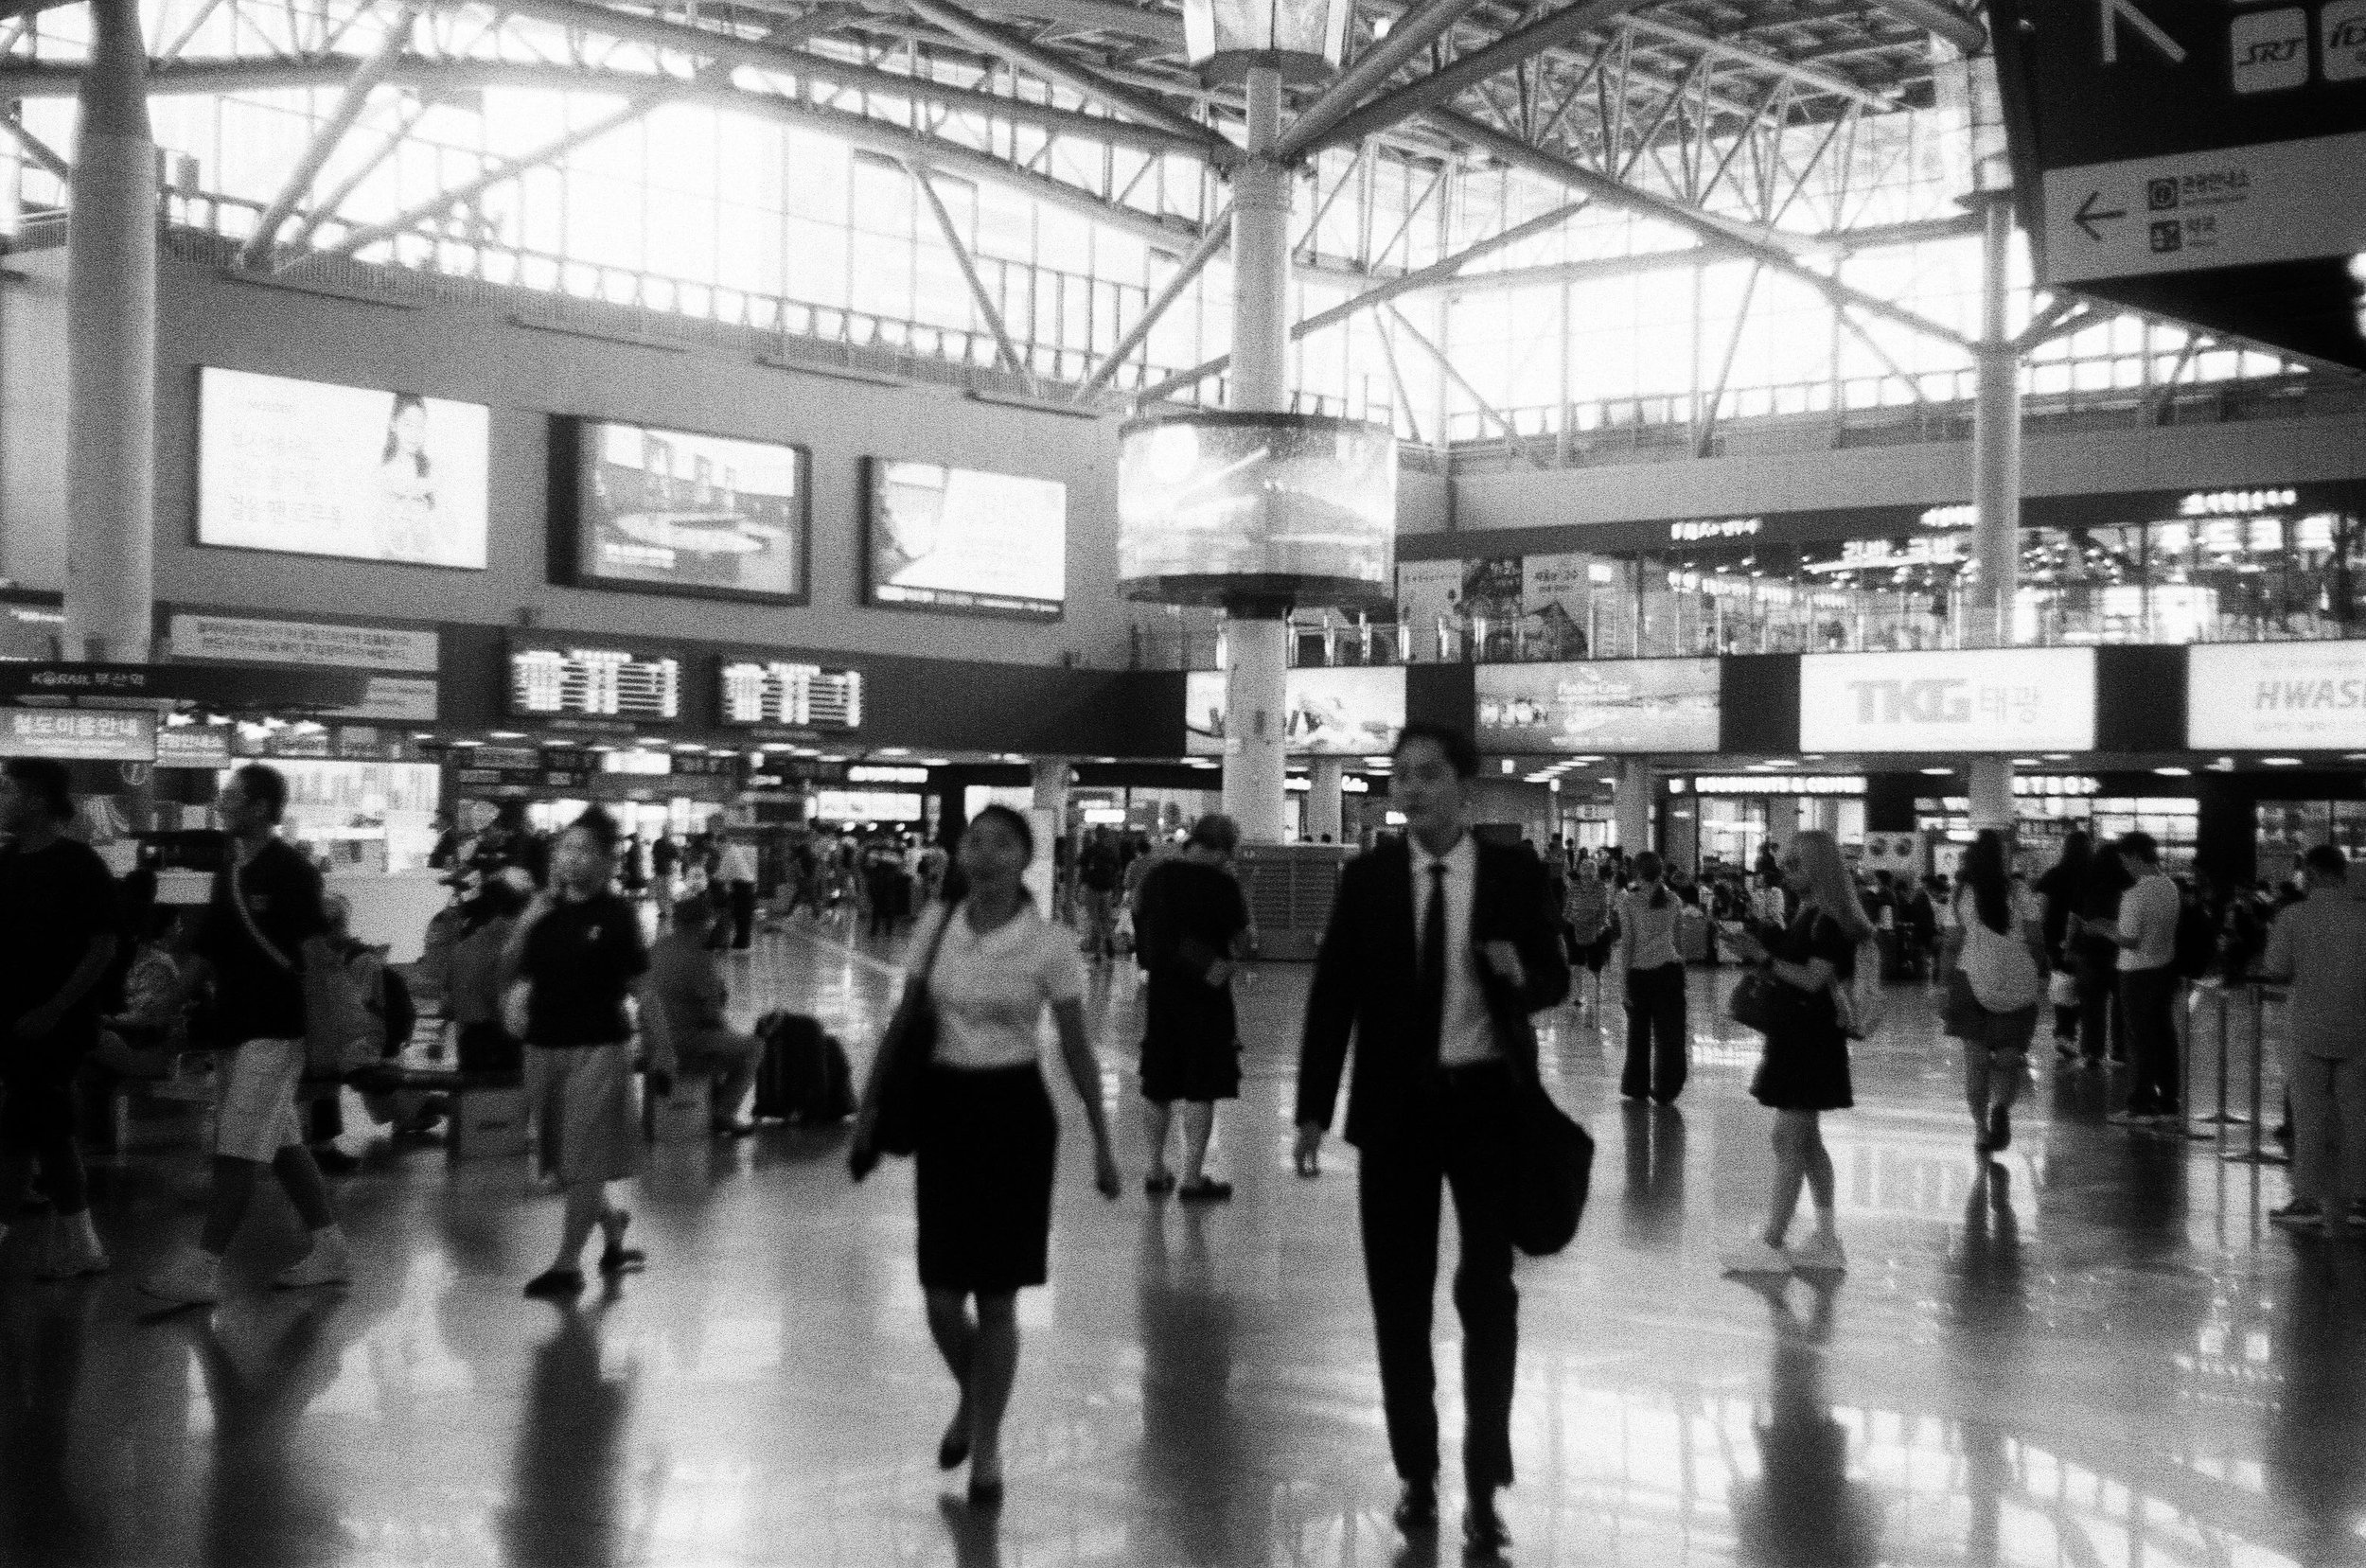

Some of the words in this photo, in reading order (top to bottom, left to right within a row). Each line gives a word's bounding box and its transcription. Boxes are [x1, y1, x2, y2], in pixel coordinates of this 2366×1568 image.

[2237, 38, 2304, 67] SRT
[30, 670, 91, 686] KORAIL
[95, 672, 146, 688] 부산역
[1846, 678, 1971, 724] TKG
[1979, 684, 2041, 725] 태광
[2255, 678, 2366, 711] HWAS
[2012, 776, 2102, 795] RTBOX
